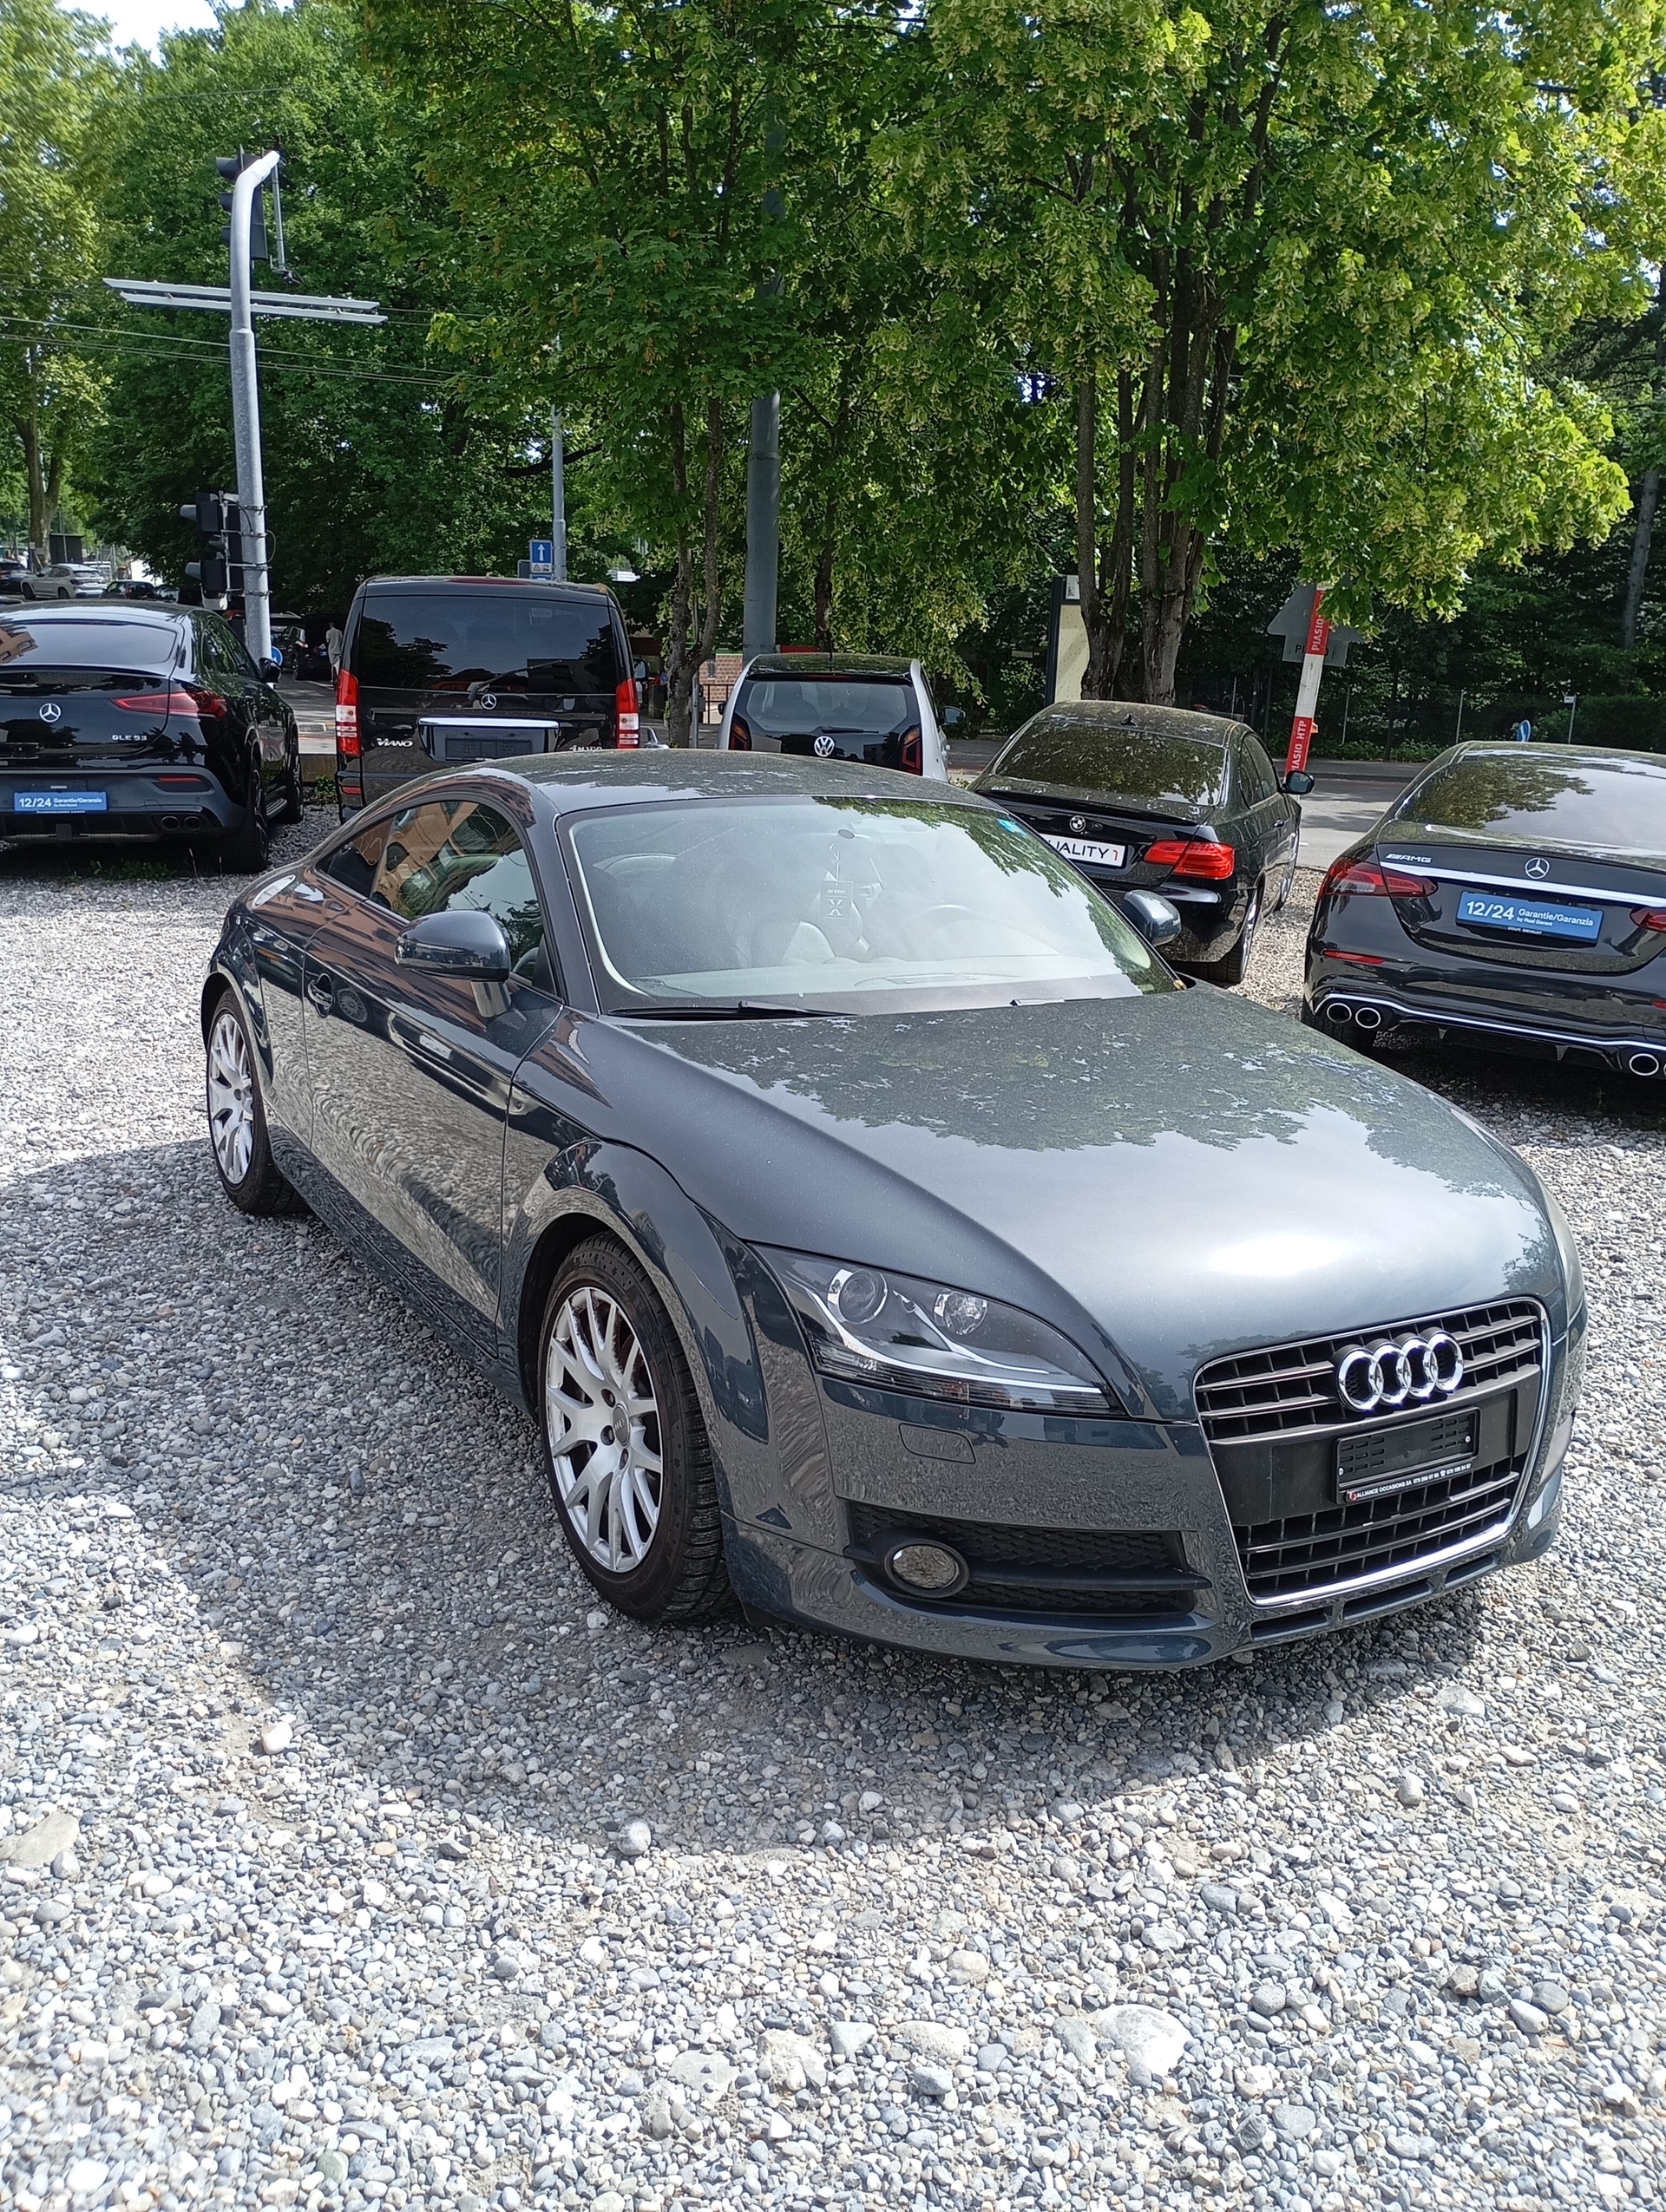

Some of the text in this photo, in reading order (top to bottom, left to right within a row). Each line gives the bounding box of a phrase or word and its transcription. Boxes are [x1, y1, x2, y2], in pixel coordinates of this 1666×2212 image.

[1311, 618, 1324, 651] PIASIO
[1290, 720, 1307, 771] IASIO HTP
[19, 798, 52, 808] 12/24
[1048, 840, 1110, 859] ALITY
[1466, 901, 1594, 926] 12/24 Garantie/Garanzia
